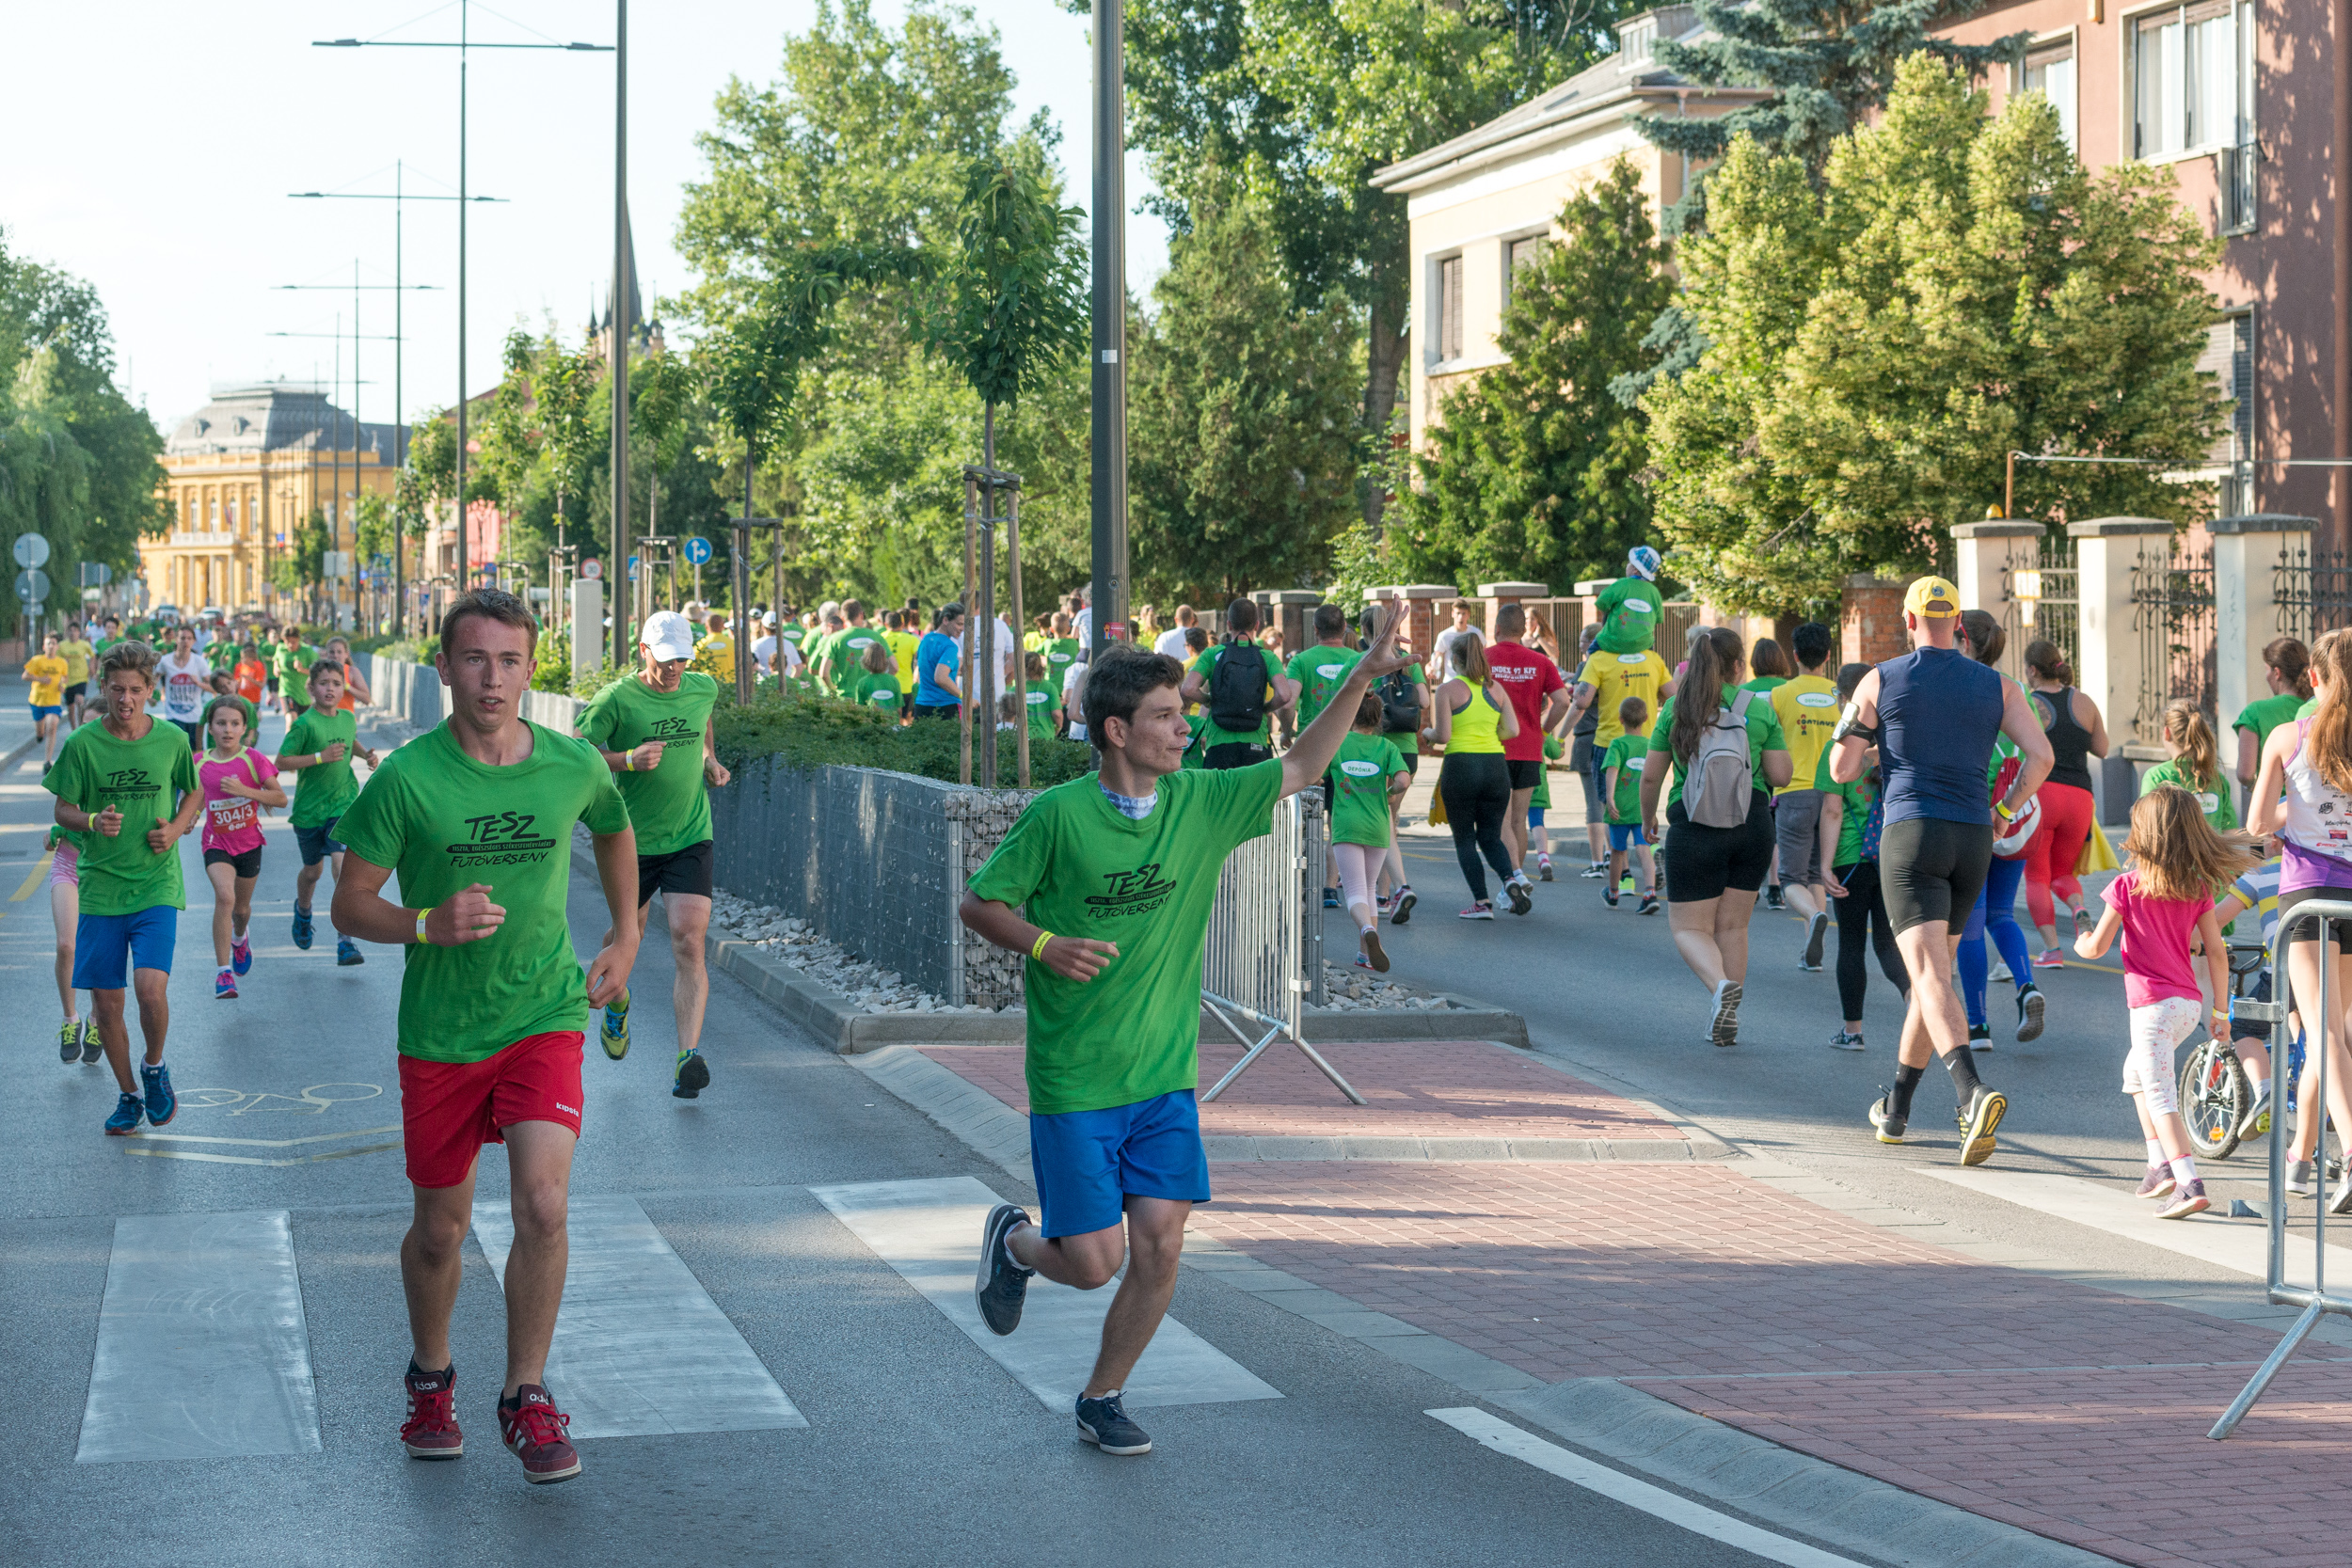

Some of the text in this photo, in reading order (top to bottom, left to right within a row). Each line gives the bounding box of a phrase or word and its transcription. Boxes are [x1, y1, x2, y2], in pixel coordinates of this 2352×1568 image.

[651, 717, 691, 735] TESZ
[106, 768, 151, 786] TESZ
[214, 804, 254, 825] 304/3
[464, 811, 540, 843] TESZ
[450, 851, 549, 868] FUTÓVERSENY
[1103, 863, 1166, 895] TESZ
